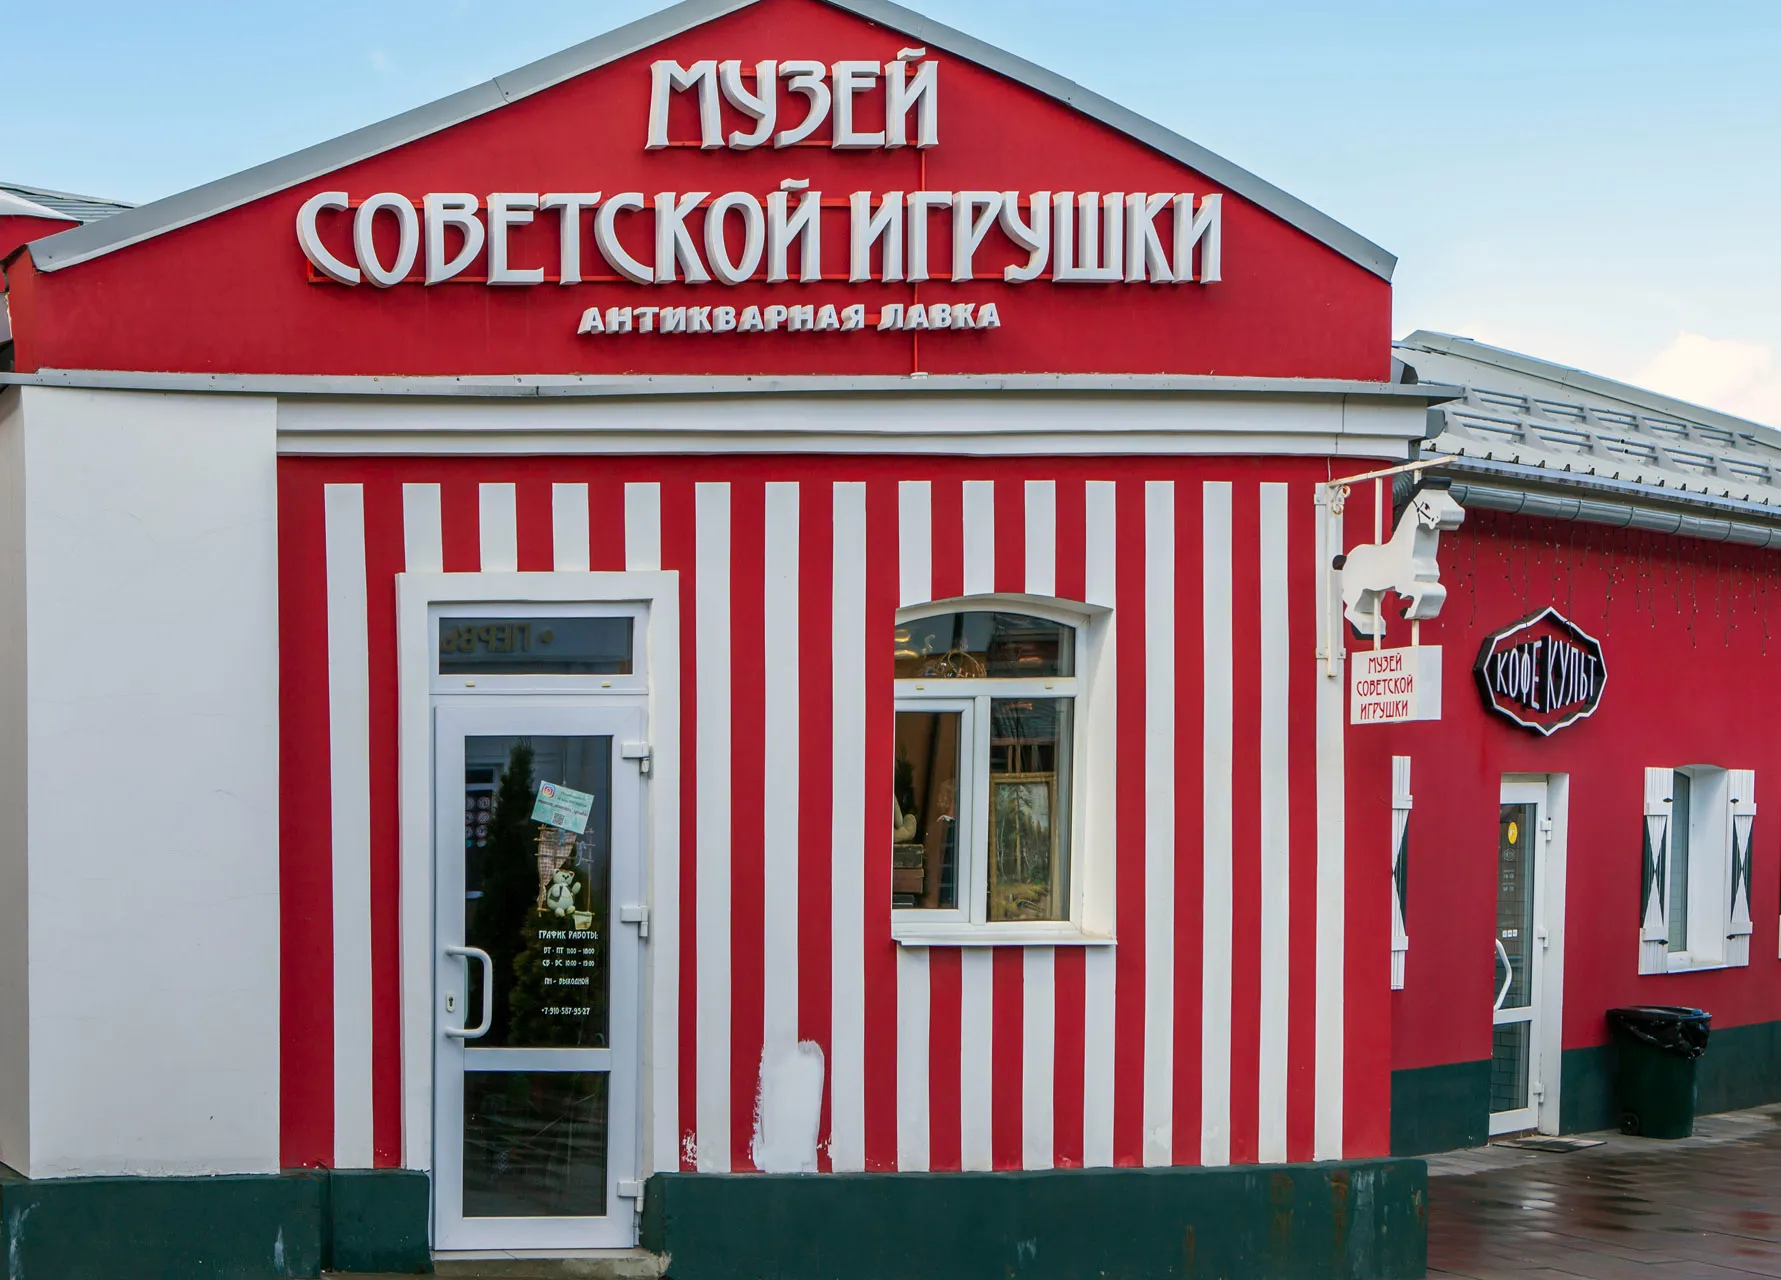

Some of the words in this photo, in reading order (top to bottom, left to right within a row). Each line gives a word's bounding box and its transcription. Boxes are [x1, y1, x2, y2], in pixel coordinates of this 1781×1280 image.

[645, 47, 939, 151] МУЗЕЙ
[296, 178, 822, 288] СОВЕТСКОЙ
[849, 190, 1223, 285] ИГРУШКИ
[577, 303, 866, 334] АНТИКВАРНАЯ
[877, 302, 1001, 331] ЛАВКА
[1368, 652, 1403, 674] МУЗЕЙ
[1496, 640, 1543, 710] КОФЕ
[1546, 634, 1598, 714] КУЛЬТ
[1356, 674, 1414, 697] СОВЕТСКОЙ
[1360, 700, 1409, 720] ИГРУШКИ
[538, 930, 567, 939] ГРАФИК
[559, 977, 590, 985] ВЫХОДНОЙ
